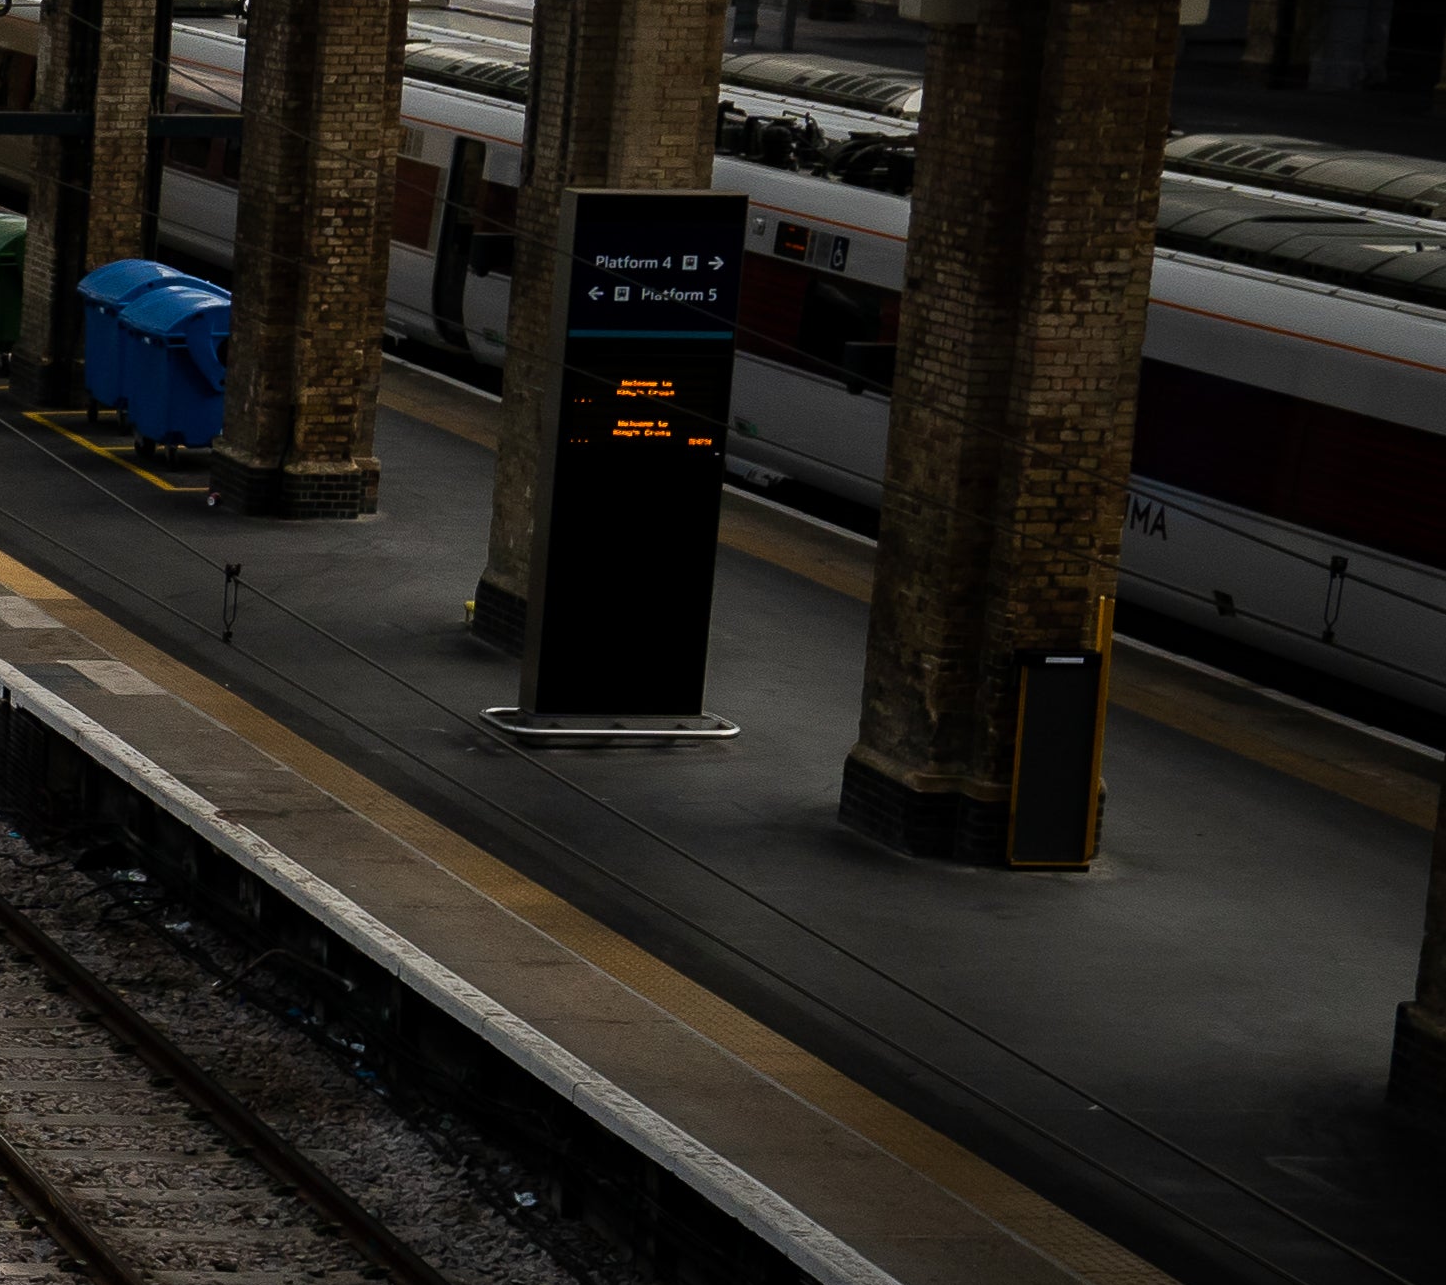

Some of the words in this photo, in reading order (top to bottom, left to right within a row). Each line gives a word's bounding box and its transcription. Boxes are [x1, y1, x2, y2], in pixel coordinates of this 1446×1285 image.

[595, 254, 659, 269] Platform
[662, 255, 672, 270] 4
[641, 287, 704, 302] Platform
[707, 288, 718, 302] 5
